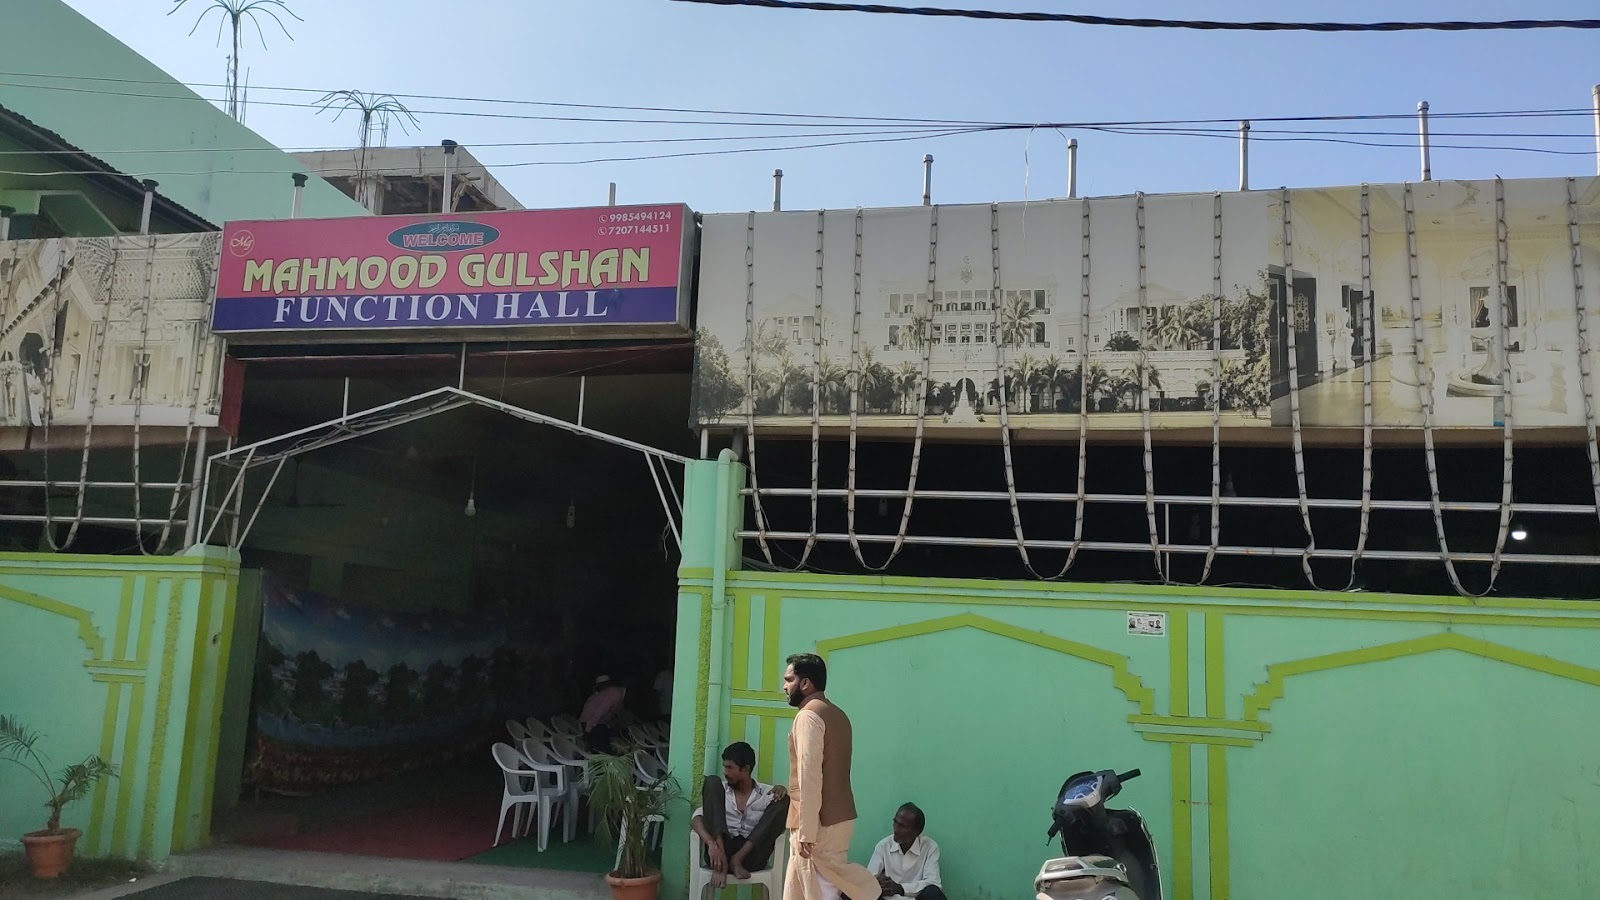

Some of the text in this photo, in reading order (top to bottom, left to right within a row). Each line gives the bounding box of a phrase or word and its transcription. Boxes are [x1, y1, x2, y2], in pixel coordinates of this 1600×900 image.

[609, 211, 672, 223] 9985494124
[608, 223, 670, 236] 7207144511
[403, 232, 483, 248] WELCOME
[242, 247, 650, 294] MAHMOOD GULSHAN
[273, 290, 608, 323] FUNCTION HALL
